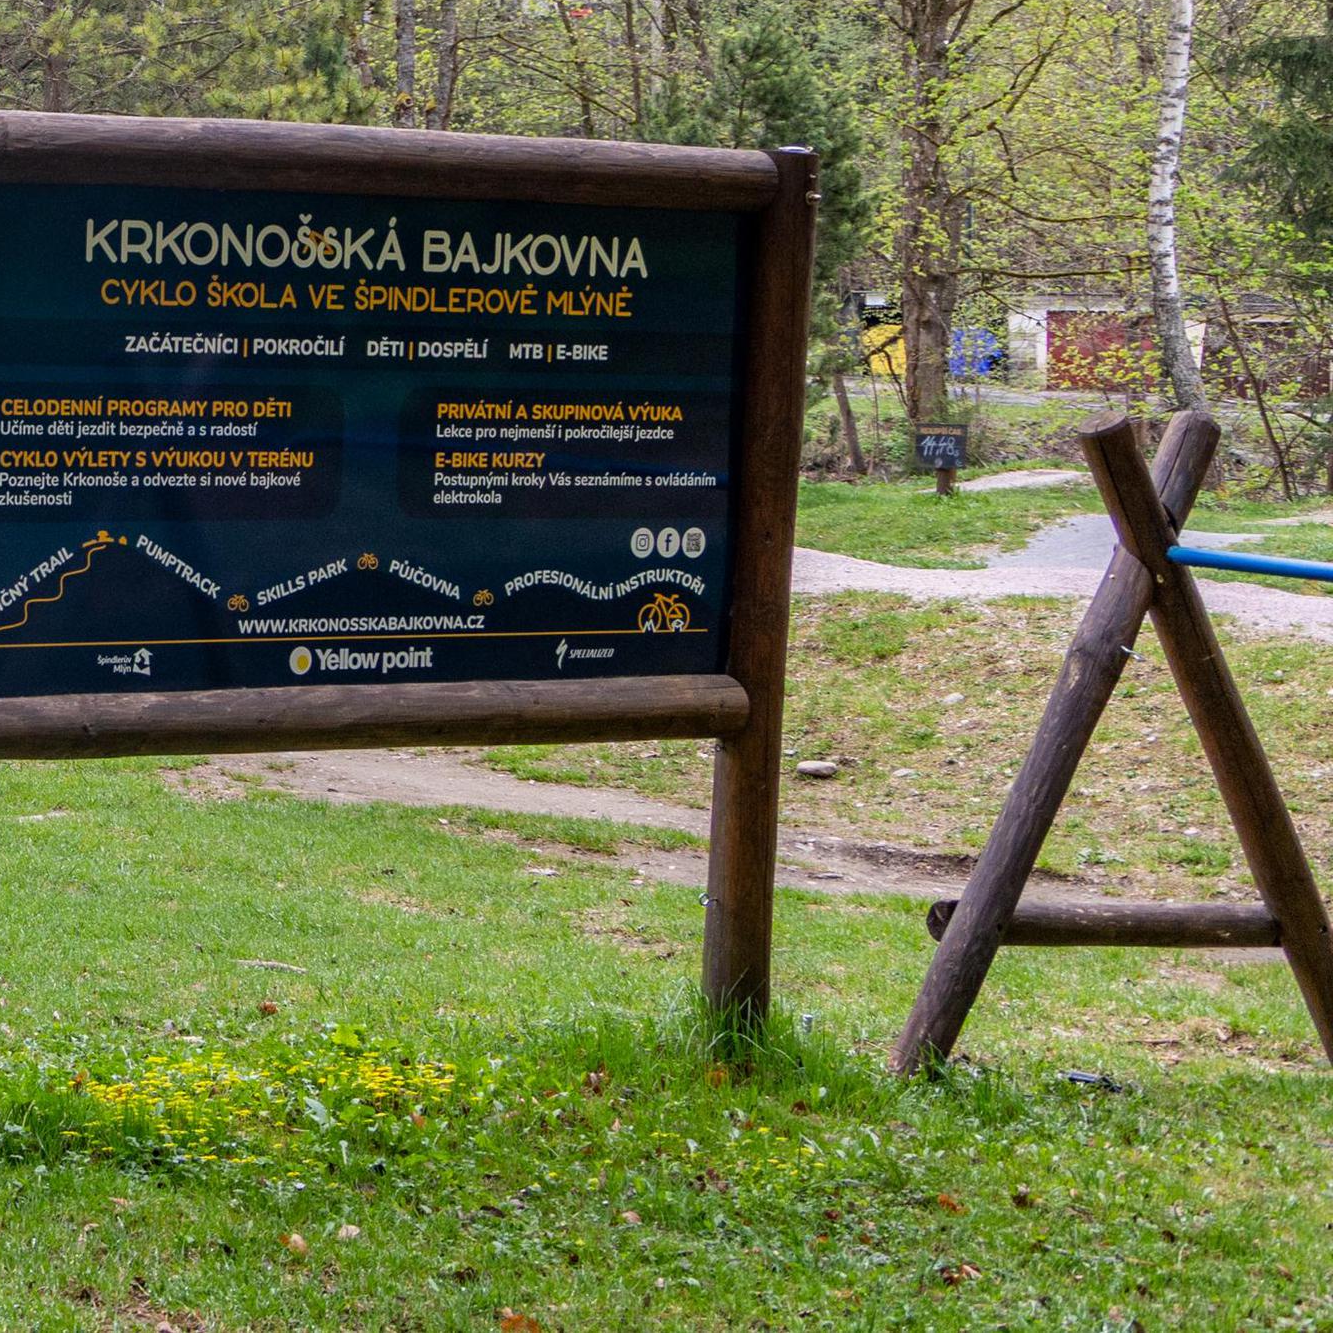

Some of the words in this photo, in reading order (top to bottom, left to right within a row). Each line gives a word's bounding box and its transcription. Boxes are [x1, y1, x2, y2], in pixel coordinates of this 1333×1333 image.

[86, 213, 405, 271] KRKONOŠSKÁ
[423, 230, 648, 278] BAJKOVNA
[101, 278, 197, 306] CYKLO
[207, 274, 297, 309] ŠKOLA
[308, 284, 345, 310] VE
[547, 284, 633, 317] MLÝNĚ
[125, 332, 238, 354] ZAČÁTEČNÍCI
[253, 335, 345, 356] POKROČILÍ
[366, 336, 404, 357] DĚTI
[418, 338, 489, 359] DOSPĚLÍ
[509, 343, 544, 360] MTB
[556, 344, 609, 361] E-BIKE
[1, 396, 103, 417] CELODENNÍ
[107, 399, 208, 417] PROGRAMY
[211, 401, 249, 417] PRO
[253, 397, 292, 418] DĚTI
[437, 400, 513, 419] PRIVÁTNÍ
[515, 405, 528, 420] A
[532, 402, 624, 420] SKUPINOVÁ
[628, 402, 683, 421] VÝUKA
[0, 420, 43, 436] Učíme
[48, 421, 74, 436] děti
[76, 421, 116, 439] jezdit
[119, 421, 184, 439] bezpečně
[188, 425, 196, 437] a
[199, 425, 207, 437] s
[210, 422, 258, 437] radostí
[436, 424, 473, 438] Lekce
[475, 427, 497, 441] pro
[499, 424, 556, 441] nejmenší
[558, 425, 562, 439] i
[565, 424, 634, 442] pokročilejší
[634, 425, 675, 442] jezdce
[0, 450, 58, 468] CYKLO
[63, 447, 131, 468] VÝLETY
[135, 451, 147, 468] S
[151, 447, 226, 468] VÝUKOU
[230, 451, 243, 468] V
[247, 447, 314, 468] TERÉNU
[435, 452, 488, 468] E-BIKE
[492, 452, 545, 468] KURZY
[63, 472, 128, 487] Krkonoše
[131, 475, 139, 487] a
[143, 472, 196, 487] odvezte
[199, 472, 211, 487] si
[214, 472, 247, 487] nové
[250, 472, 301, 489] bajkové
[434, 472, 509, 489] Postupnými
[511, 472, 546, 489] kroky
[548, 472, 572, 486] Vás
[574, 472, 643, 487] seznámíme
[645, 475, 652, 487] s
[654, 472, 716, 487] ovládáním
[433, 490, 502, 504] elektrokola
[29, 547, 74, 584] TRAIL
[136, 534, 222, 599] PUMPTRACK
[256, 576, 306, 606] SKILLS
[308, 558, 348, 586] PARK
[389, 559, 460, 600] PŮJČOVNA
[504, 569, 614, 601] PROFESIONÁLNÍ
[615, 568, 705, 598] INSTRUKTOŘI
[238, 615, 485, 634] WWW.KRKONOSSKABAJKOVNA.CZ
[315, 648, 379, 671] Yellow
[382, 646, 433, 673] point
